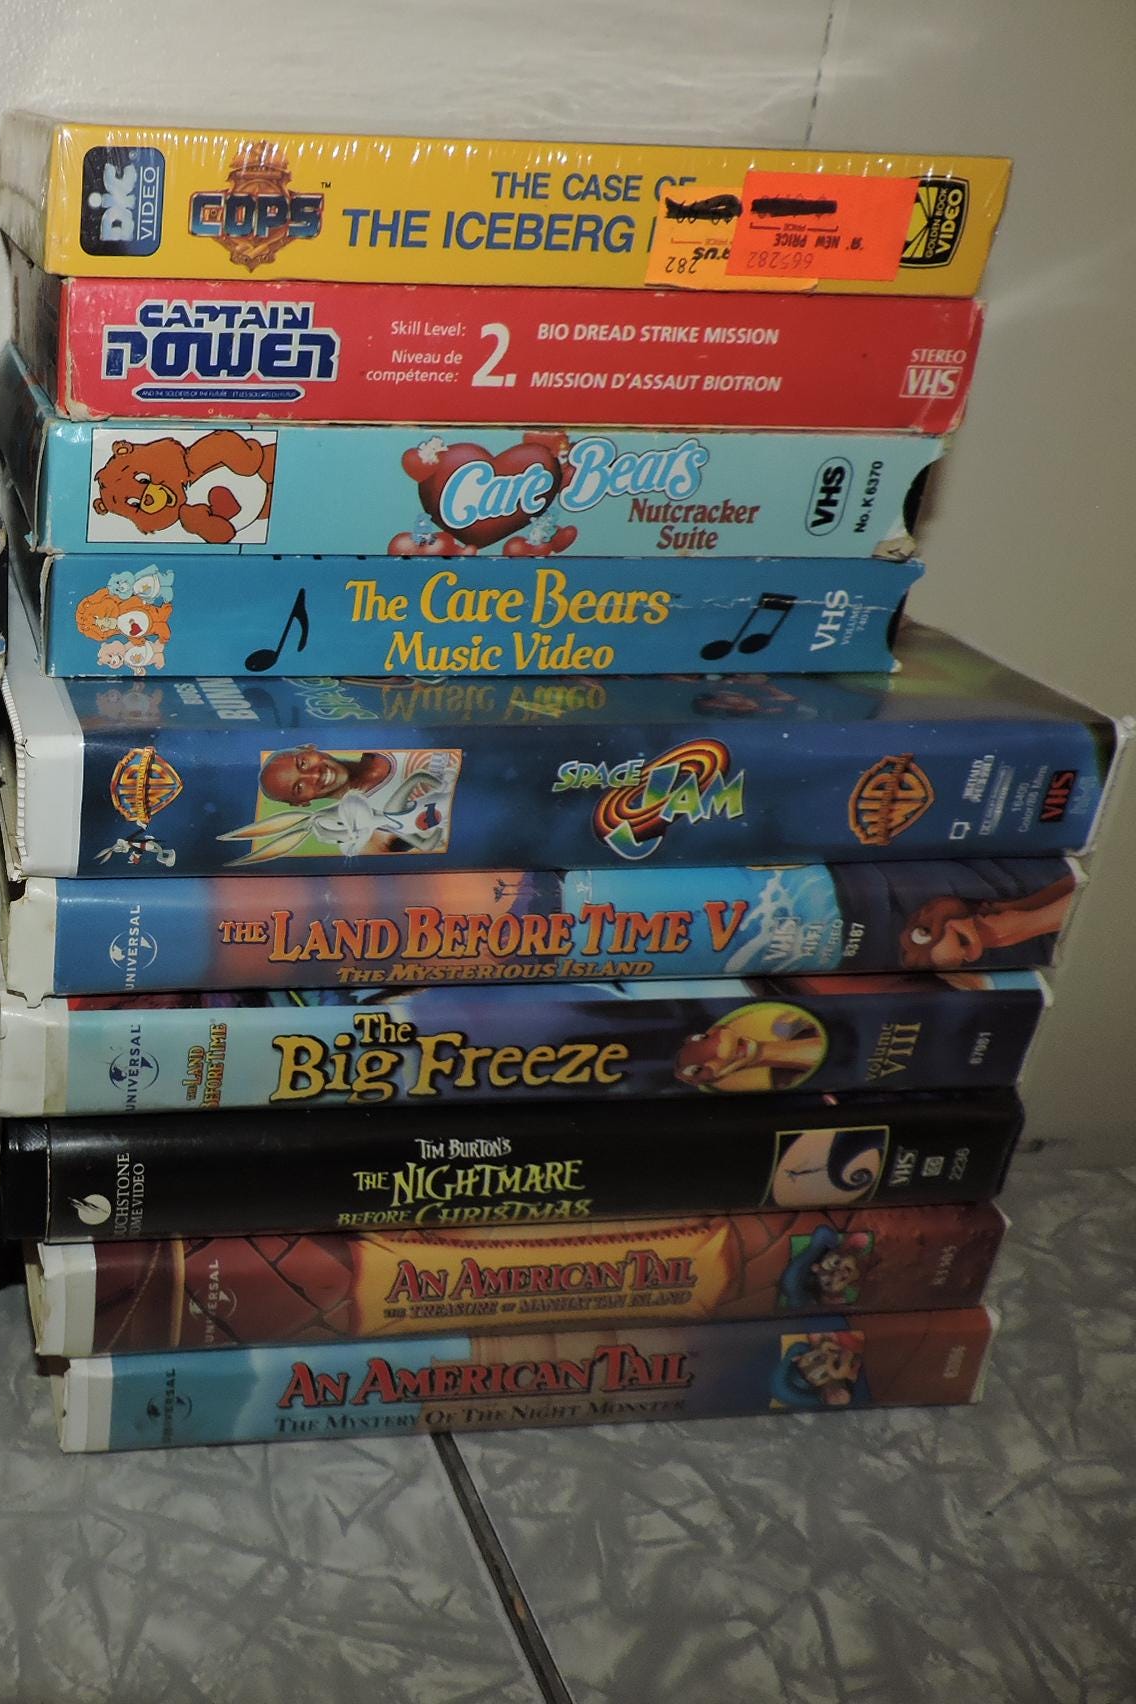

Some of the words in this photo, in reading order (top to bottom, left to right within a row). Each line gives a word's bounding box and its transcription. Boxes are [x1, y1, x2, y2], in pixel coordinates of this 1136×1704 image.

[138, 165, 158, 242] VIDEO
[491, 171, 550, 201] THE
[562, 172, 643, 202] CASE
[187, 191, 326, 239] COPS
[342, 208, 430, 248] THE
[442, 211, 636, 254] ICEBERG
[924, 217, 942, 258] GOLDEN
[934, 188, 948, 216] BOOK
[934, 188, 964, 255] VIDEO
[773, 232, 807, 249] PRICE
[815, 234, 841, 249] NEW
[138, 301, 316, 331] CAPTAIN
[391, 320, 420, 337] Skill
[423, 321, 467, 338] Level:
[537, 323, 570, 341] BIO
[573, 324, 636, 342] DREAD
[640, 325, 700, 343] STRIKE
[703, 326, 779, 345] MISSION
[103, 326, 341, 381] POWER
[391, 349, 440, 366] Niveau
[444, 350, 464, 366] de
[470, 322, 517, 388] 2.
[910, 348, 967, 364] STEREO
[365, 367, 459, 386] compétence:
[530, 371, 606, 390] MISSION
[611, 371, 701, 391] D'ASSAUT
[704, 373, 782, 393] BIOTRON
[905, 367, 958, 398] VHS
[438, 459, 556, 530] Care
[560, 435, 709, 512] Bears
[810, 465, 847, 528] VHS
[627, 497, 760, 527] Nutcracker
[656, 525, 720, 551] Suite
[345, 579, 409, 623] The
[420, 570, 524, 625] Care
[531, 568, 672, 628] Bears
[809, 588, 851, 652] VHS
[382, 631, 504, 672] Music
[512, 632, 615, 671] Video
[551, 758, 646, 794] SPACE
[1040, 771, 1075, 820] VHS
[124, 904, 143, 992] UNIVERSAL
[219, 919, 268, 945] THE
[268, 910, 401, 964] LAND
[401, 904, 575, 961] BEFORE
[578, 903, 691, 956] TIME
[704, 900, 750, 953] V
[337, 965, 388, 984] THE
[390, 962, 556, 983] MYSTERIOUS
[562, 958, 654, 980] ISLAND
[206, 1023, 227, 1062] TIME
[354, 1012, 418, 1046] The
[124, 1024, 143, 1112] UNIVERSAL
[182, 1045, 205, 1087] LAND
[269, 1034, 404, 1105] Big
[407, 1031, 631, 1098] Freeze
[879, 1022, 922, 1078] VIII
[414, 1138, 446, 1159] TIM
[448, 1136, 512, 1159] BURTON'S
[352, 1170, 390, 1192] THE
[390, 1160, 586, 1208] NIGHTMARE
[337, 1208, 411, 1227] BEFORE
[413, 1198, 594, 1226] CHRISTMAS
[385, 1260, 449, 1303] AN
[460, 1257, 625, 1302] AMERICAN
[624, 1249, 697, 1291] TAIL
[277, 1360, 350, 1411] AN
[354, 1356, 598, 1409] AMERICAN
[595, 1342, 694, 1393] TAIL
[275, 1416, 322, 1434] THE
[325, 1413, 422, 1433] MYSTERY
[424, 1408, 459, 1427] OF
[461, 1406, 507, 1424] THE
[511, 1402, 584, 1422] NIGHT
